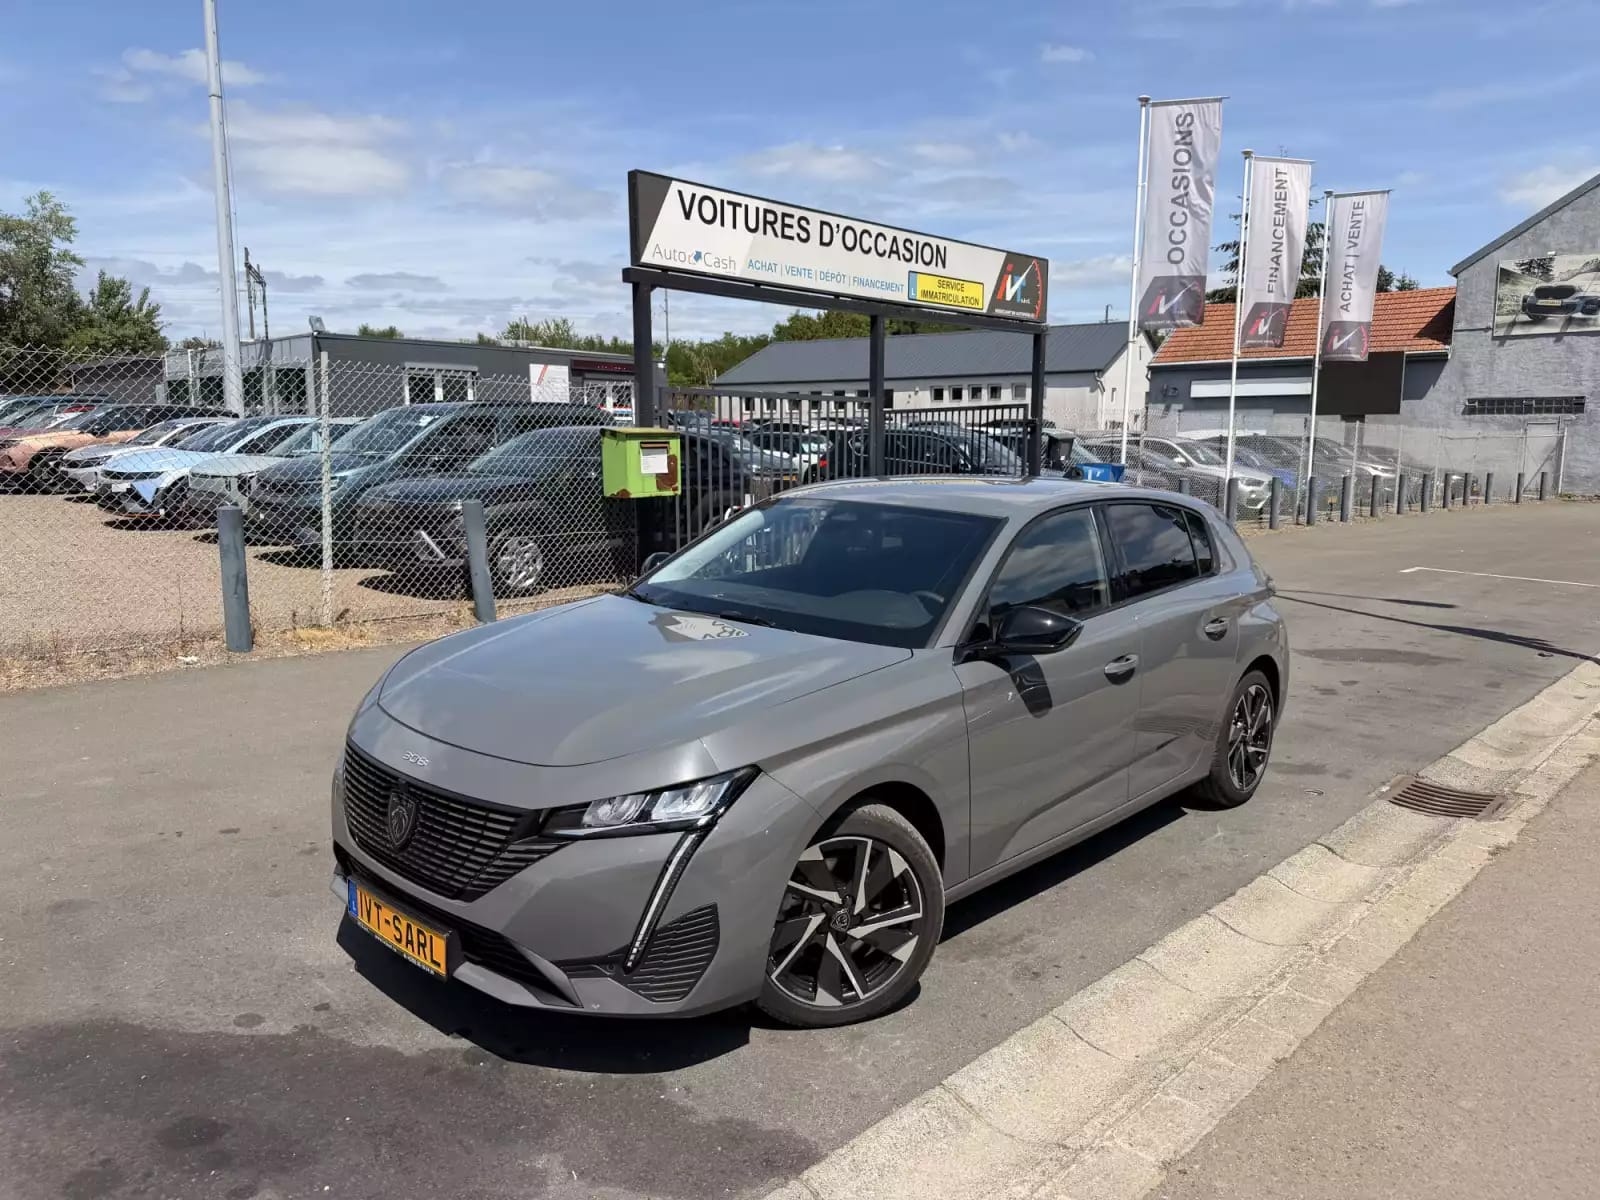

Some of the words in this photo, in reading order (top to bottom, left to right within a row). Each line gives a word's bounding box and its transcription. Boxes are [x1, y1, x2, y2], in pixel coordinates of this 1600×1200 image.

[1167, 111, 1195, 265] OCCASIONS
[677, 189, 811, 243] VOITURES
[819, 219, 947, 269] D'OCCASION
[1267, 167, 1288, 294] FINANCEMENT
[1346, 200, 1365, 253] VENTE
[652, 243, 687, 263] Auto
[703, 252, 737, 271] Cash
[748, 258, 778, 273] ACHAT
[785, 264, 813, 279] VENTE
[819, 269, 847, 284] DÉPÔT
[852, 276, 905, 293] FINANCEMENT
[920, 289, 980, 306] IMMATRICULATION
[937, 279, 965, 292] SERVICE
[1340, 264, 1354, 313] ACHAT
[359, 889, 442, 968] IVT-SARL
